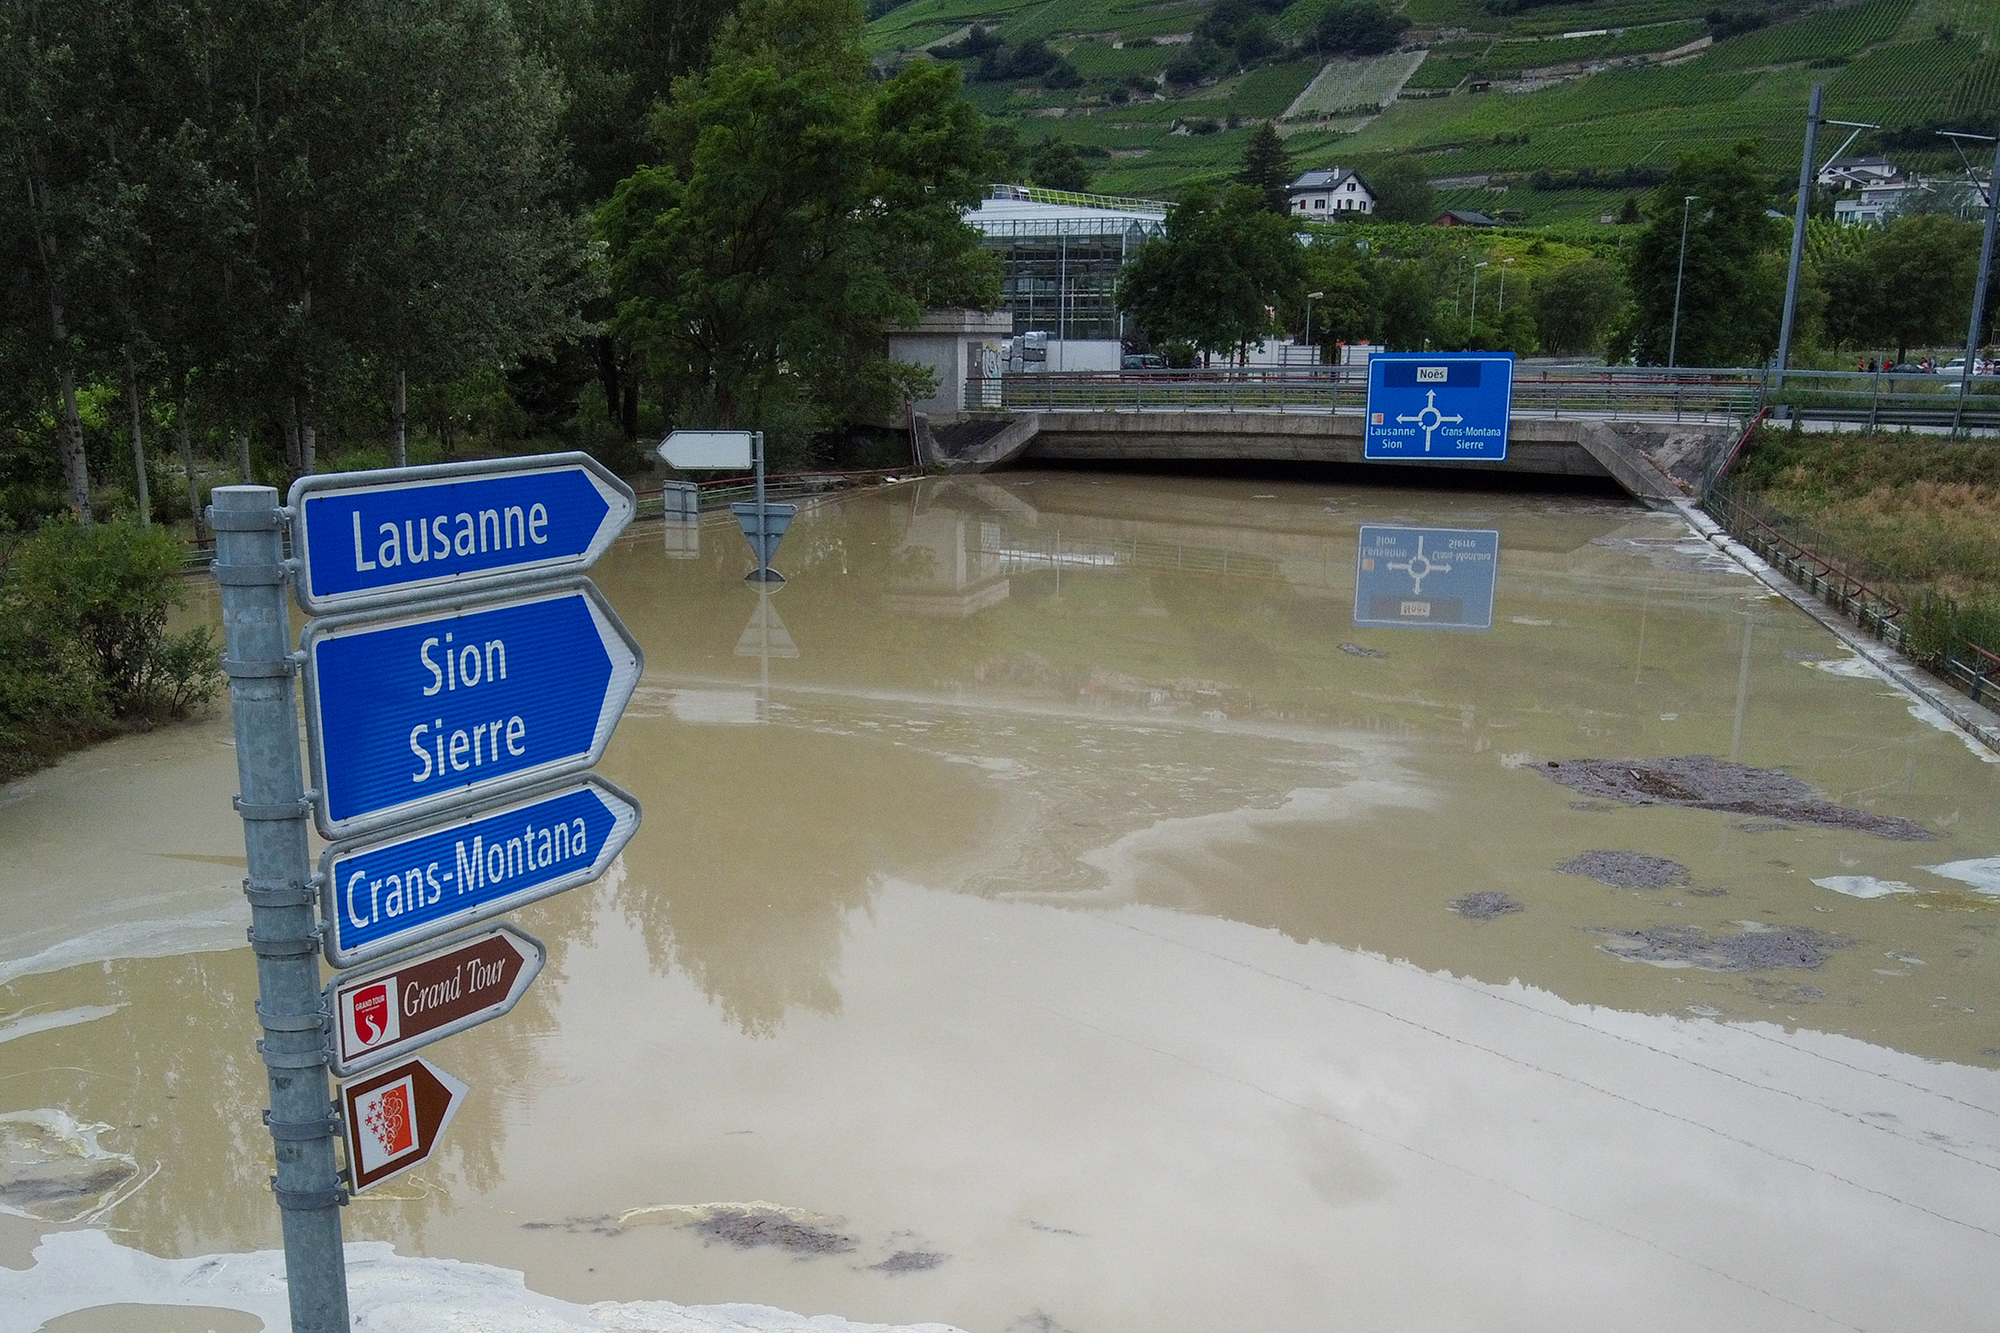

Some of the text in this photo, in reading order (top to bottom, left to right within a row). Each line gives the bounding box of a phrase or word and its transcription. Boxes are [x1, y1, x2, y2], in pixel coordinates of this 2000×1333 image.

[1419, 368, 1445, 379] Noës
[1370, 426, 1416, 437] Lausanne
[1382, 439, 1403, 449] Sion
[1440, 426, 1501, 438] Crans-Montana
[1456, 439, 1484, 450] Sierre
[352, 502, 549, 572] Lausanne
[420, 632, 507, 697] Sion
[409, 715, 526, 783] Sierre
[346, 816, 588, 929] Crans-Montana
[403, 957, 506, 1017] Grand Tour
